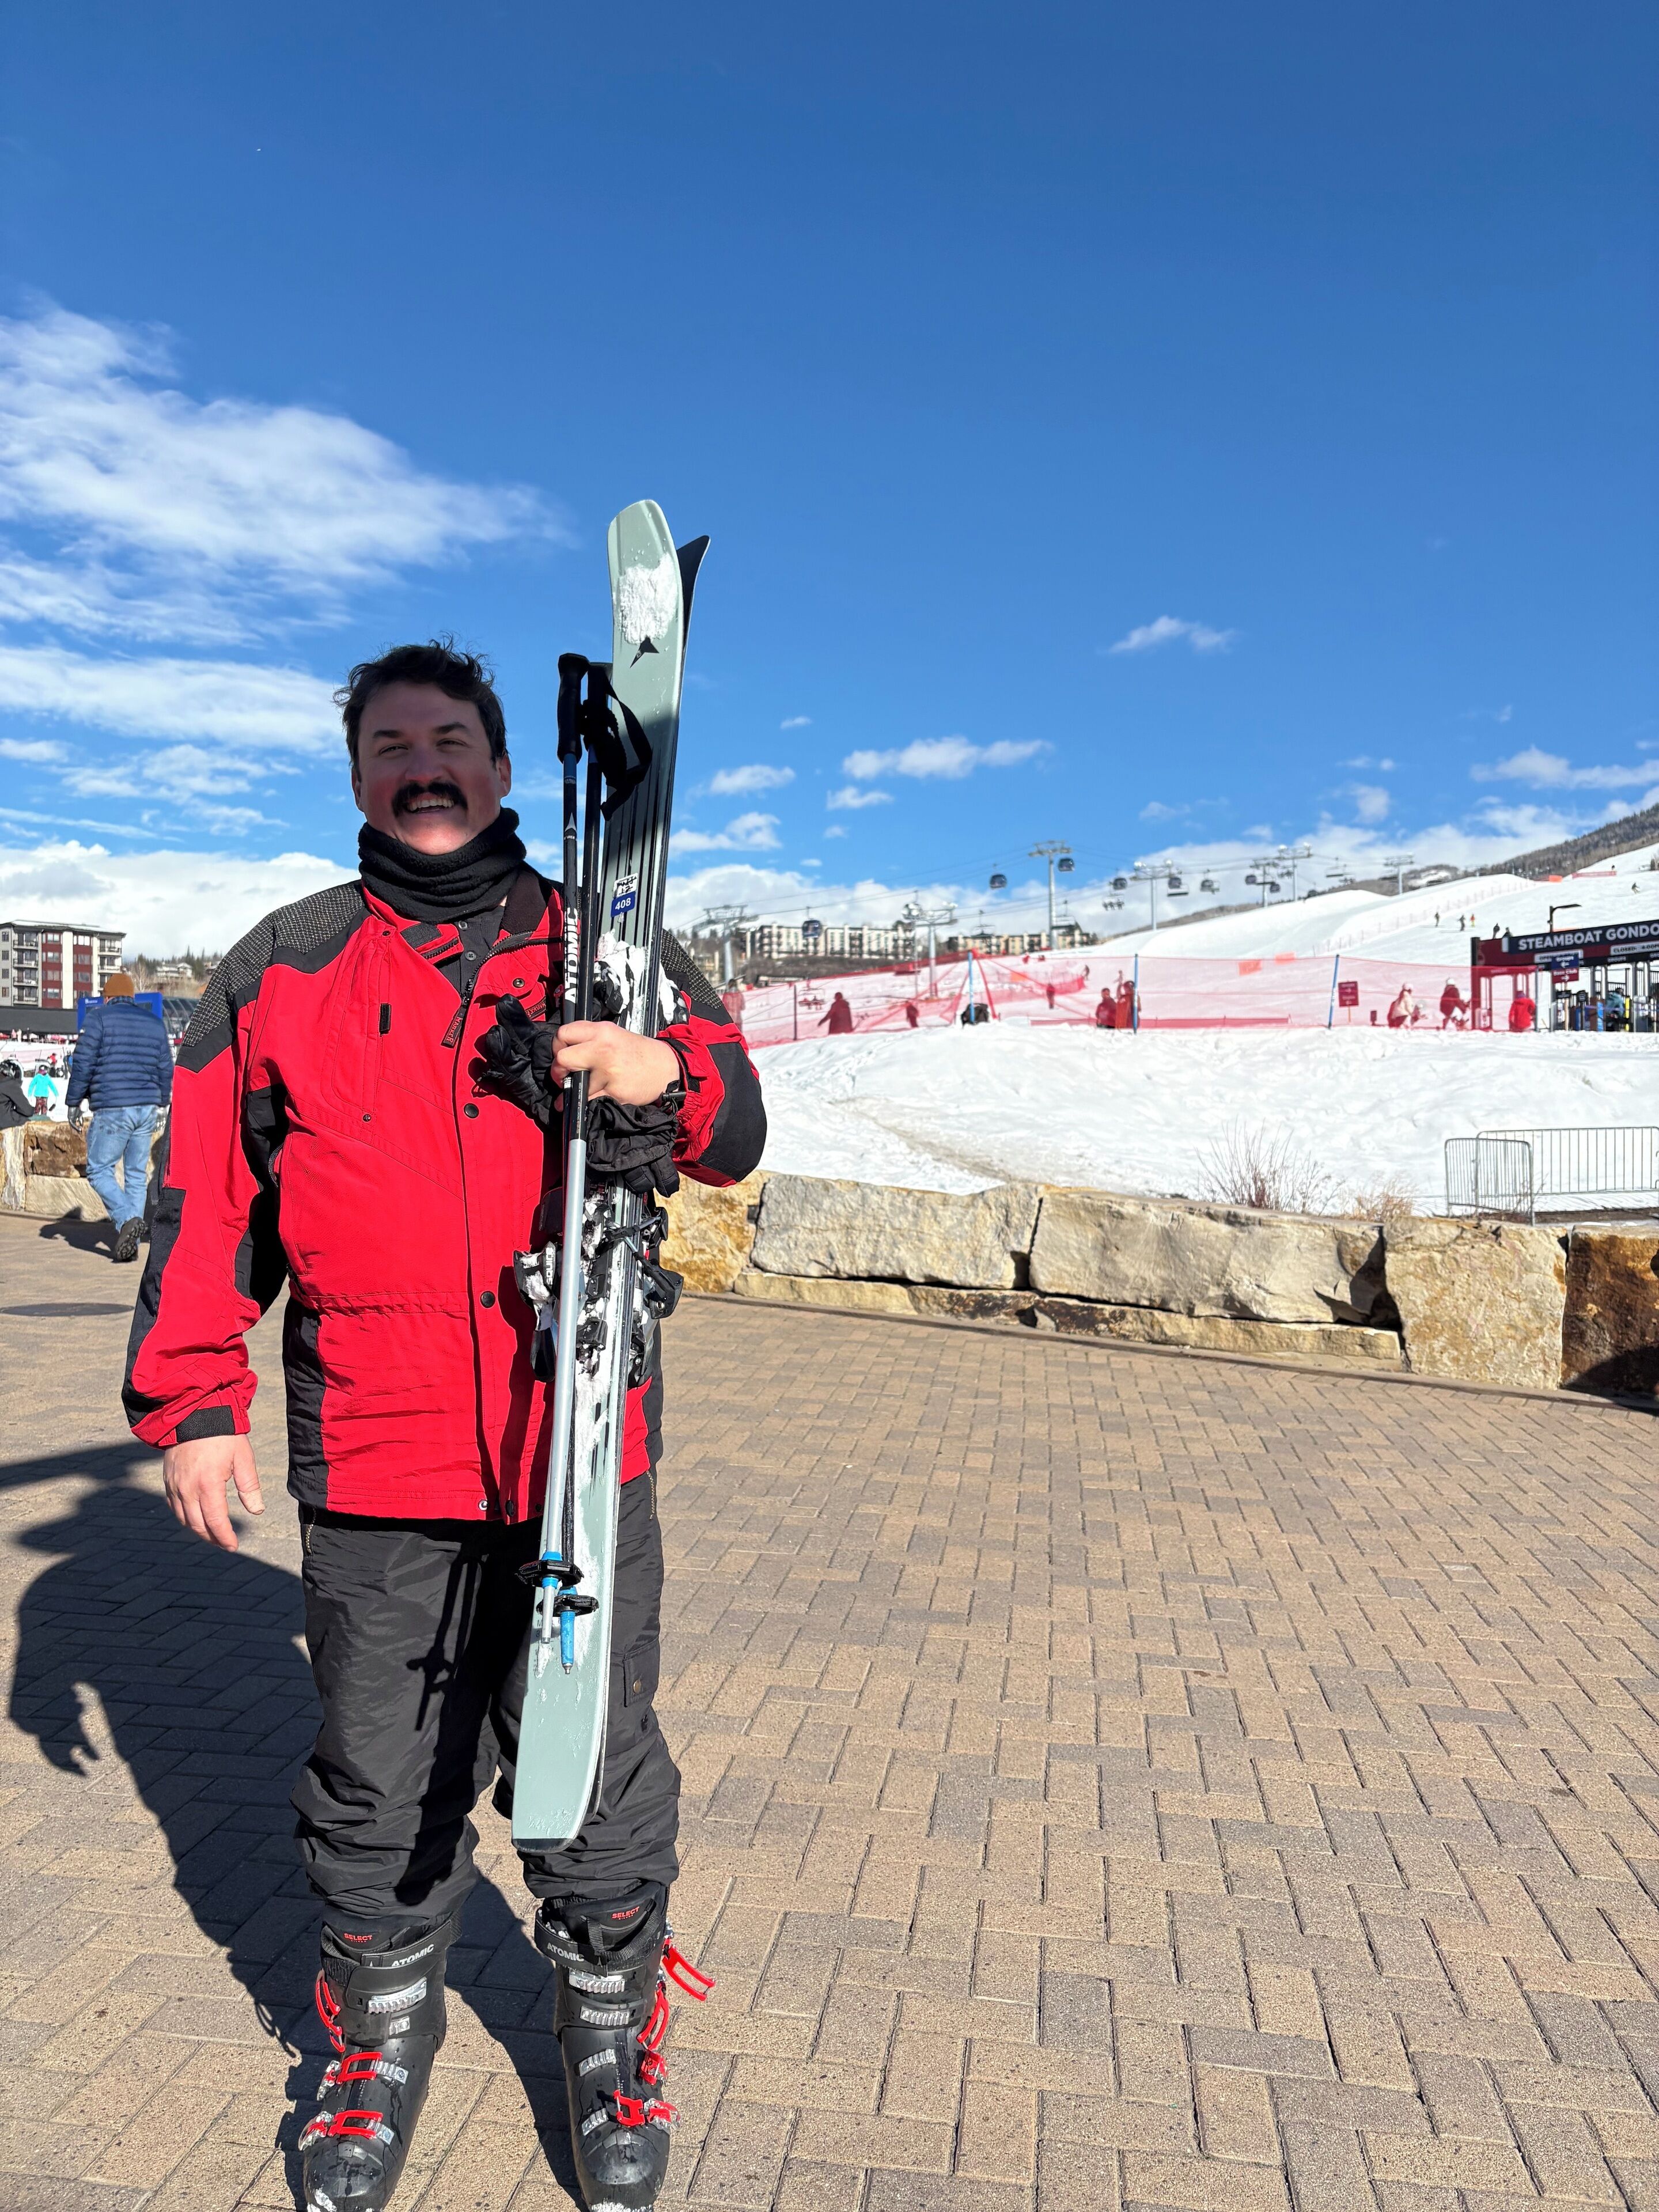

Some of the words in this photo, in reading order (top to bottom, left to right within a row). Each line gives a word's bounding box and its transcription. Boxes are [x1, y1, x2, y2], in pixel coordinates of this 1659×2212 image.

[615, 897, 631, 910] 408
[1518, 930, 1603, 951] STEAMBOAT
[565, 907, 578, 1004] ATOMIC
[446, 1017, 463, 1043] MARKER
[612, 1906, 640, 1919] SELECT
[392, 1944, 434, 1967] ATOMIC
[547, 1942, 585, 1962] ATOMIC
